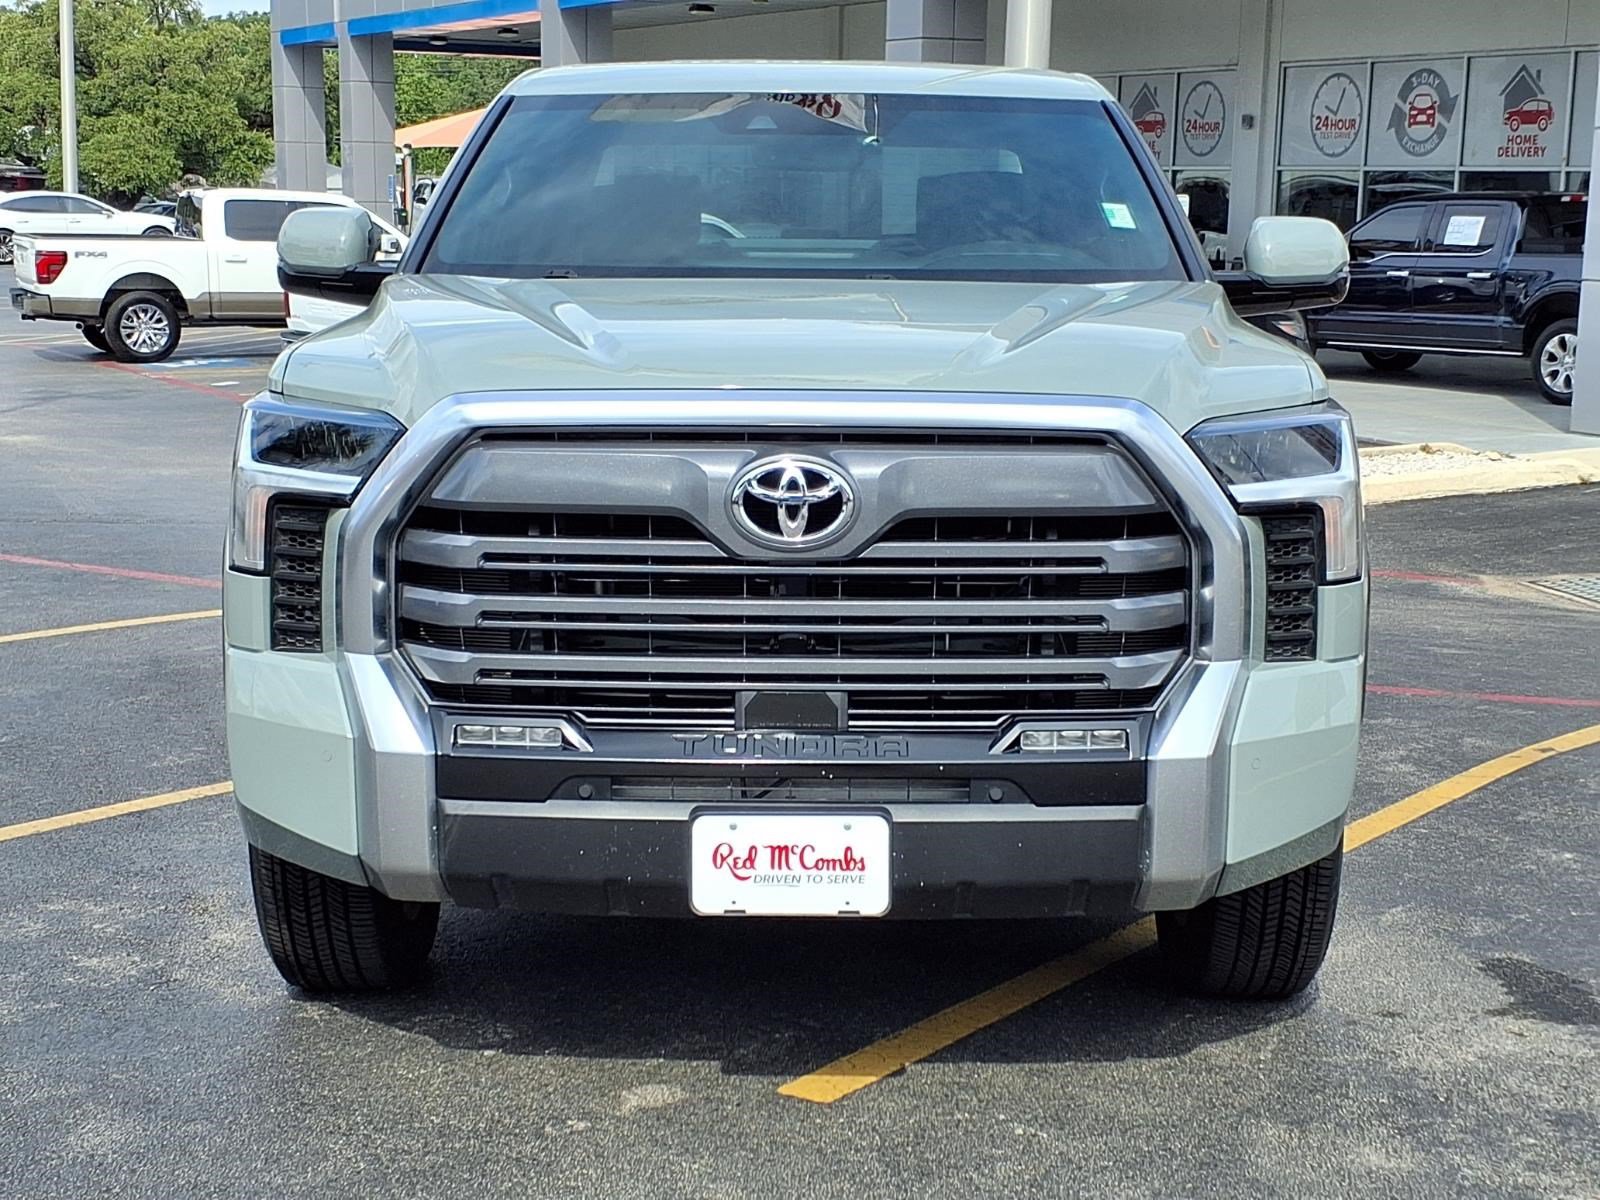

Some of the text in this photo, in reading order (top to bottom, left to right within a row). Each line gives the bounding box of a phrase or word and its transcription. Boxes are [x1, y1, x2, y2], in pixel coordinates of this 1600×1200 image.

[1185, 119, 1220, 133] 24 HOUR
[1315, 115, 1357, 131] 24 HOUR
[1402, 134, 1440, 153] EXCHANGE
[1507, 134, 1539, 145] HOME
[1497, 146, 1547, 158] DELIVERY
[672, 733, 909, 757] TUNDRA
[712, 842, 866, 881] Red McCombs
[754, 874, 866, 884] DRIVEN TO SERVE
